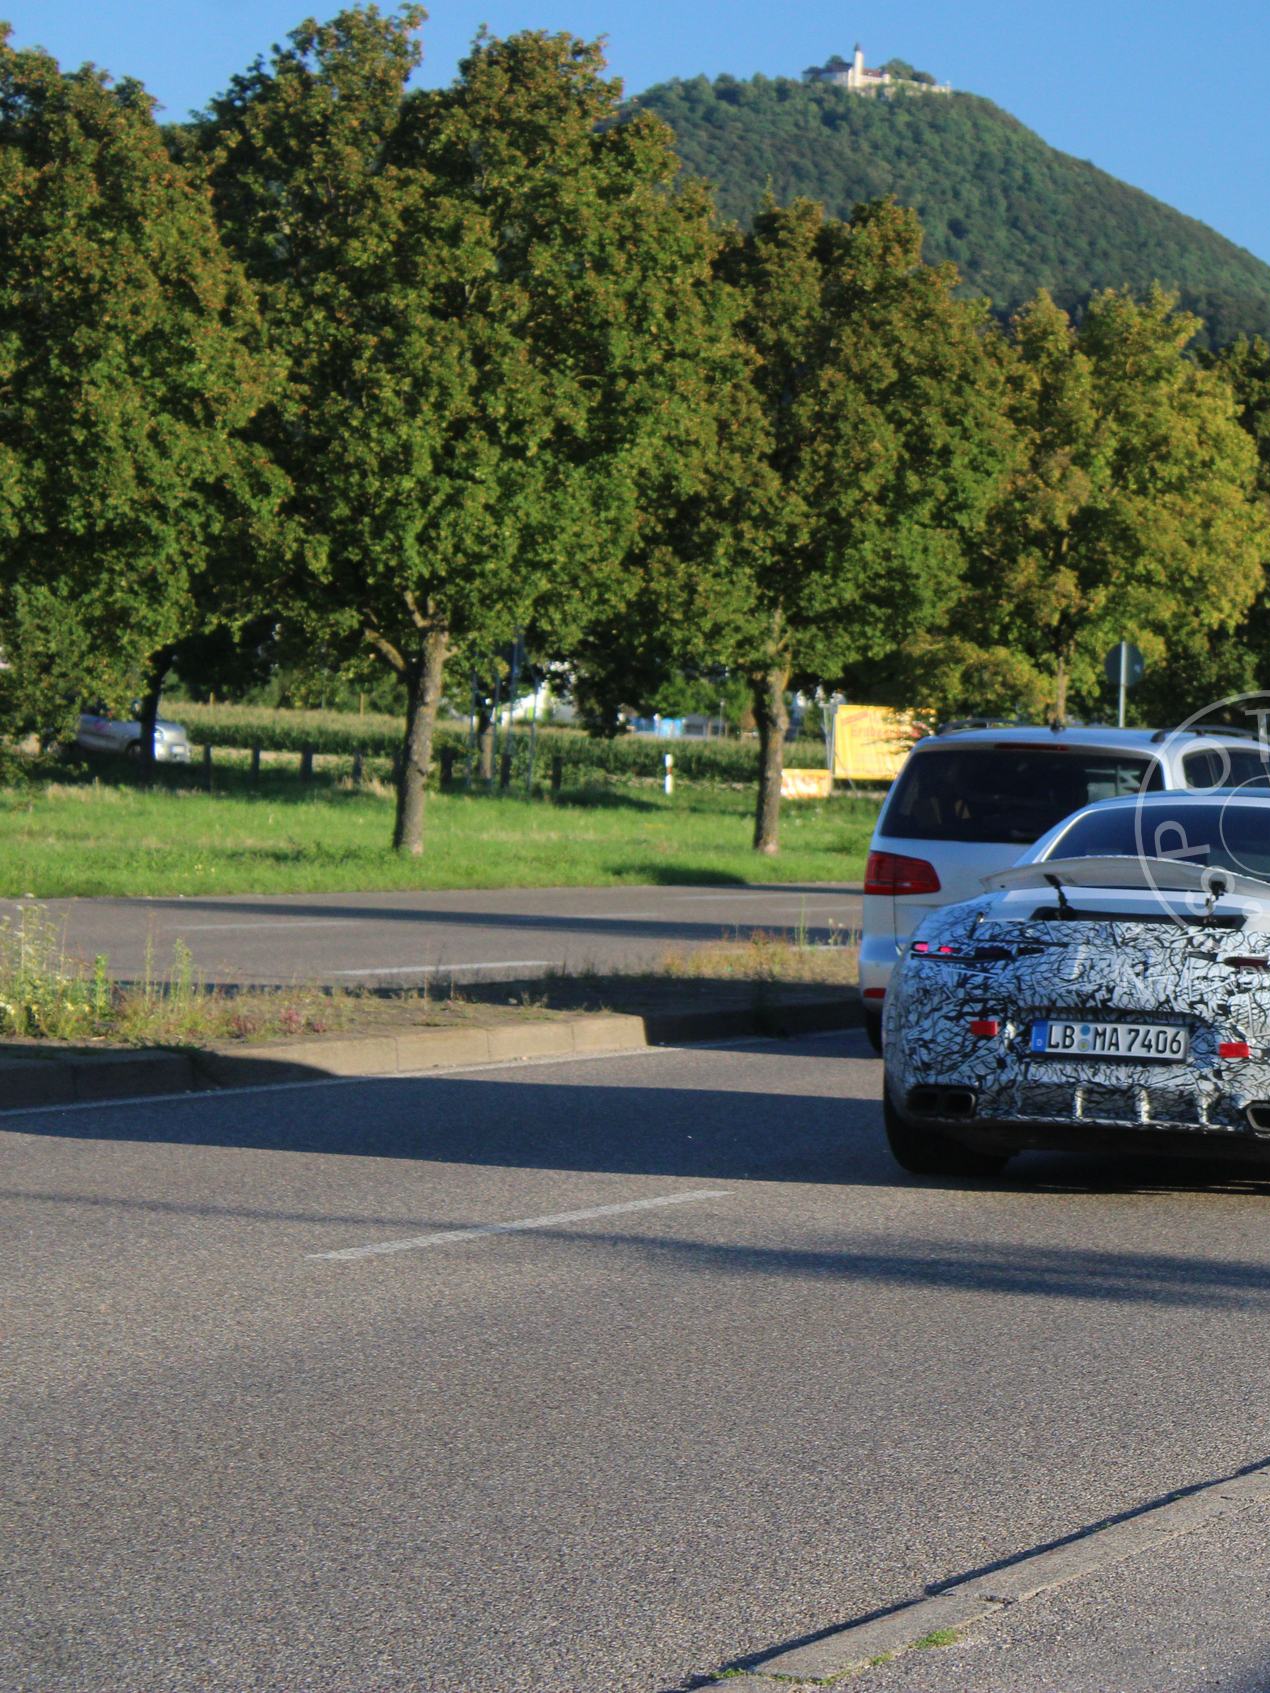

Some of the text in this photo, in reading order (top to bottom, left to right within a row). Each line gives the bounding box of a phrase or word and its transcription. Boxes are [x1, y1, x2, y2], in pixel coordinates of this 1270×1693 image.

[1048, 1024, 1182, 1055] LB MA 7406
